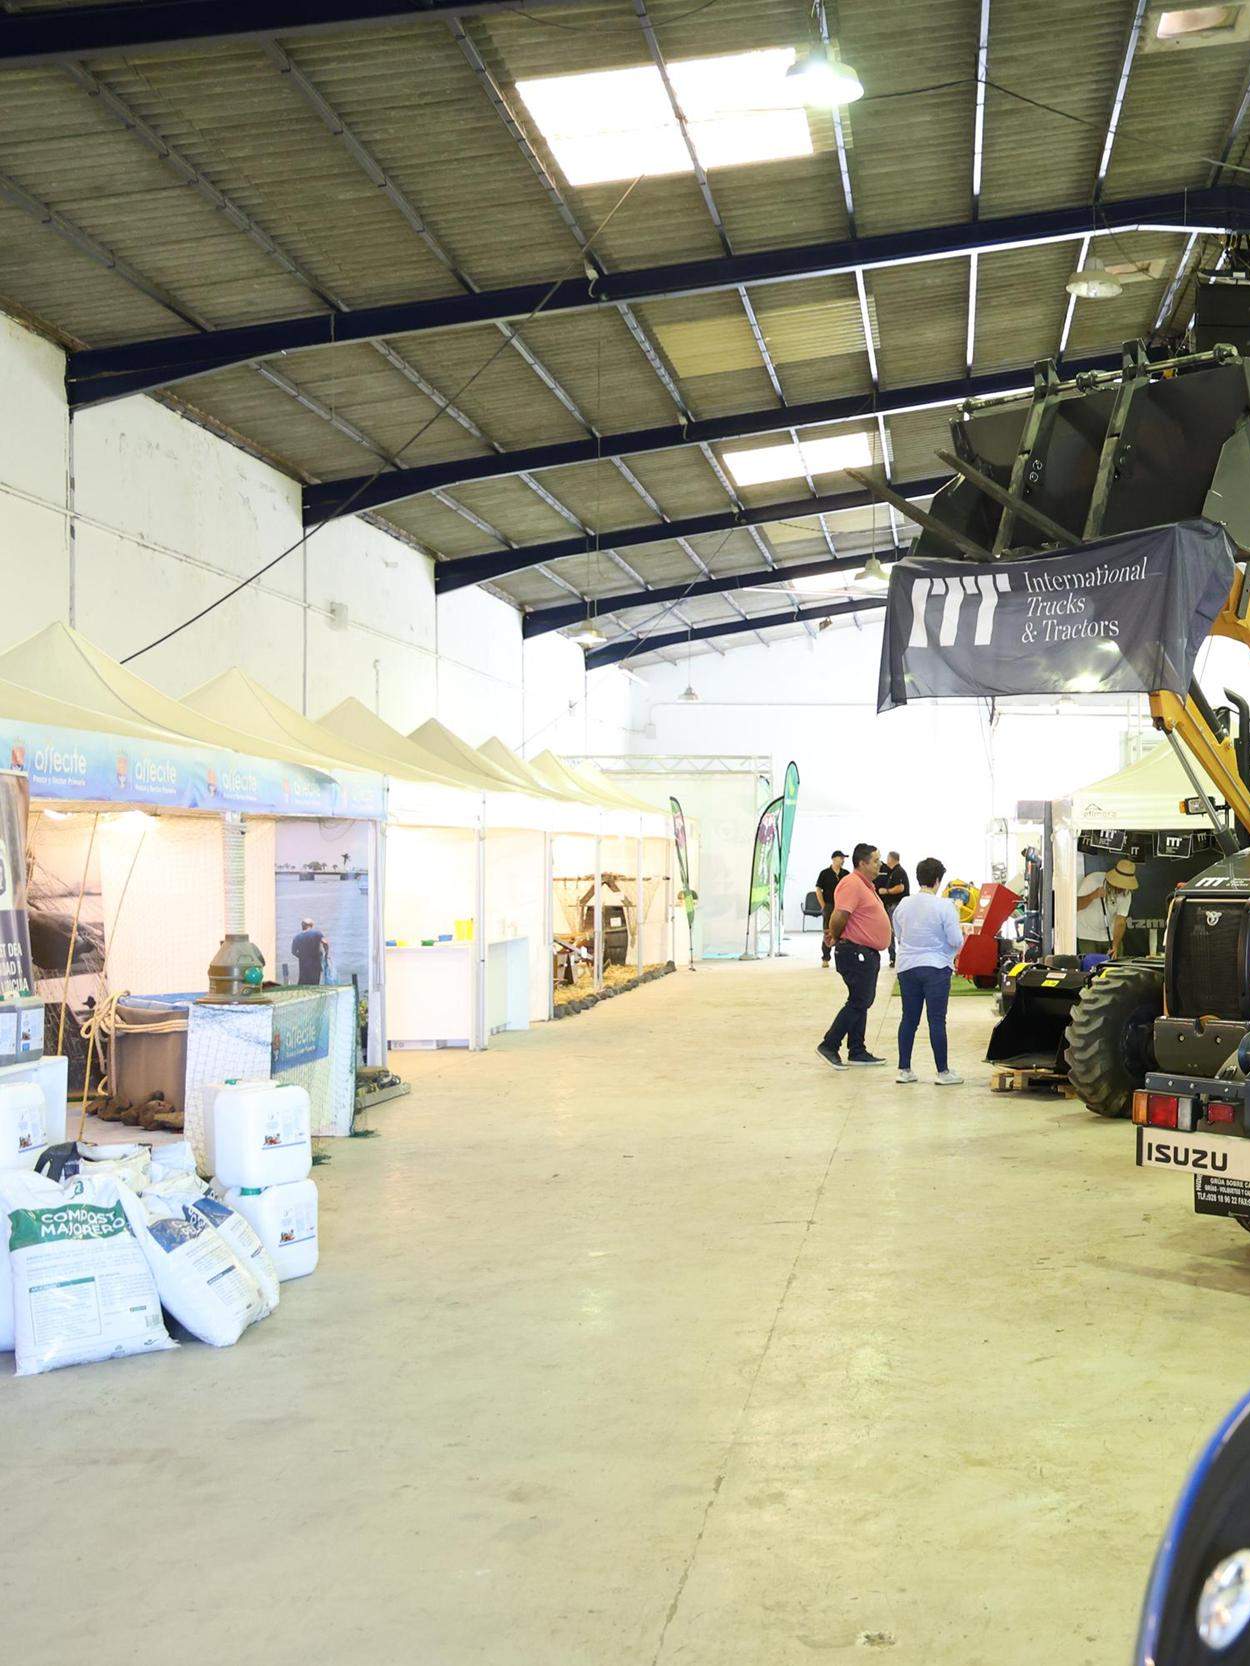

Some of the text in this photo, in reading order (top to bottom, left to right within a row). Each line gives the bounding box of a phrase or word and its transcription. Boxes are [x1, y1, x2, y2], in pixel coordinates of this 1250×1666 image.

[1023, 557, 1148, 593] International
[1026, 593, 1086, 617] Trucks
[1021, 618, 1120, 643] & Tractors
[1147, 1142, 1228, 1172] ISUZU
[41, 1208, 116, 1224] COMPOST
